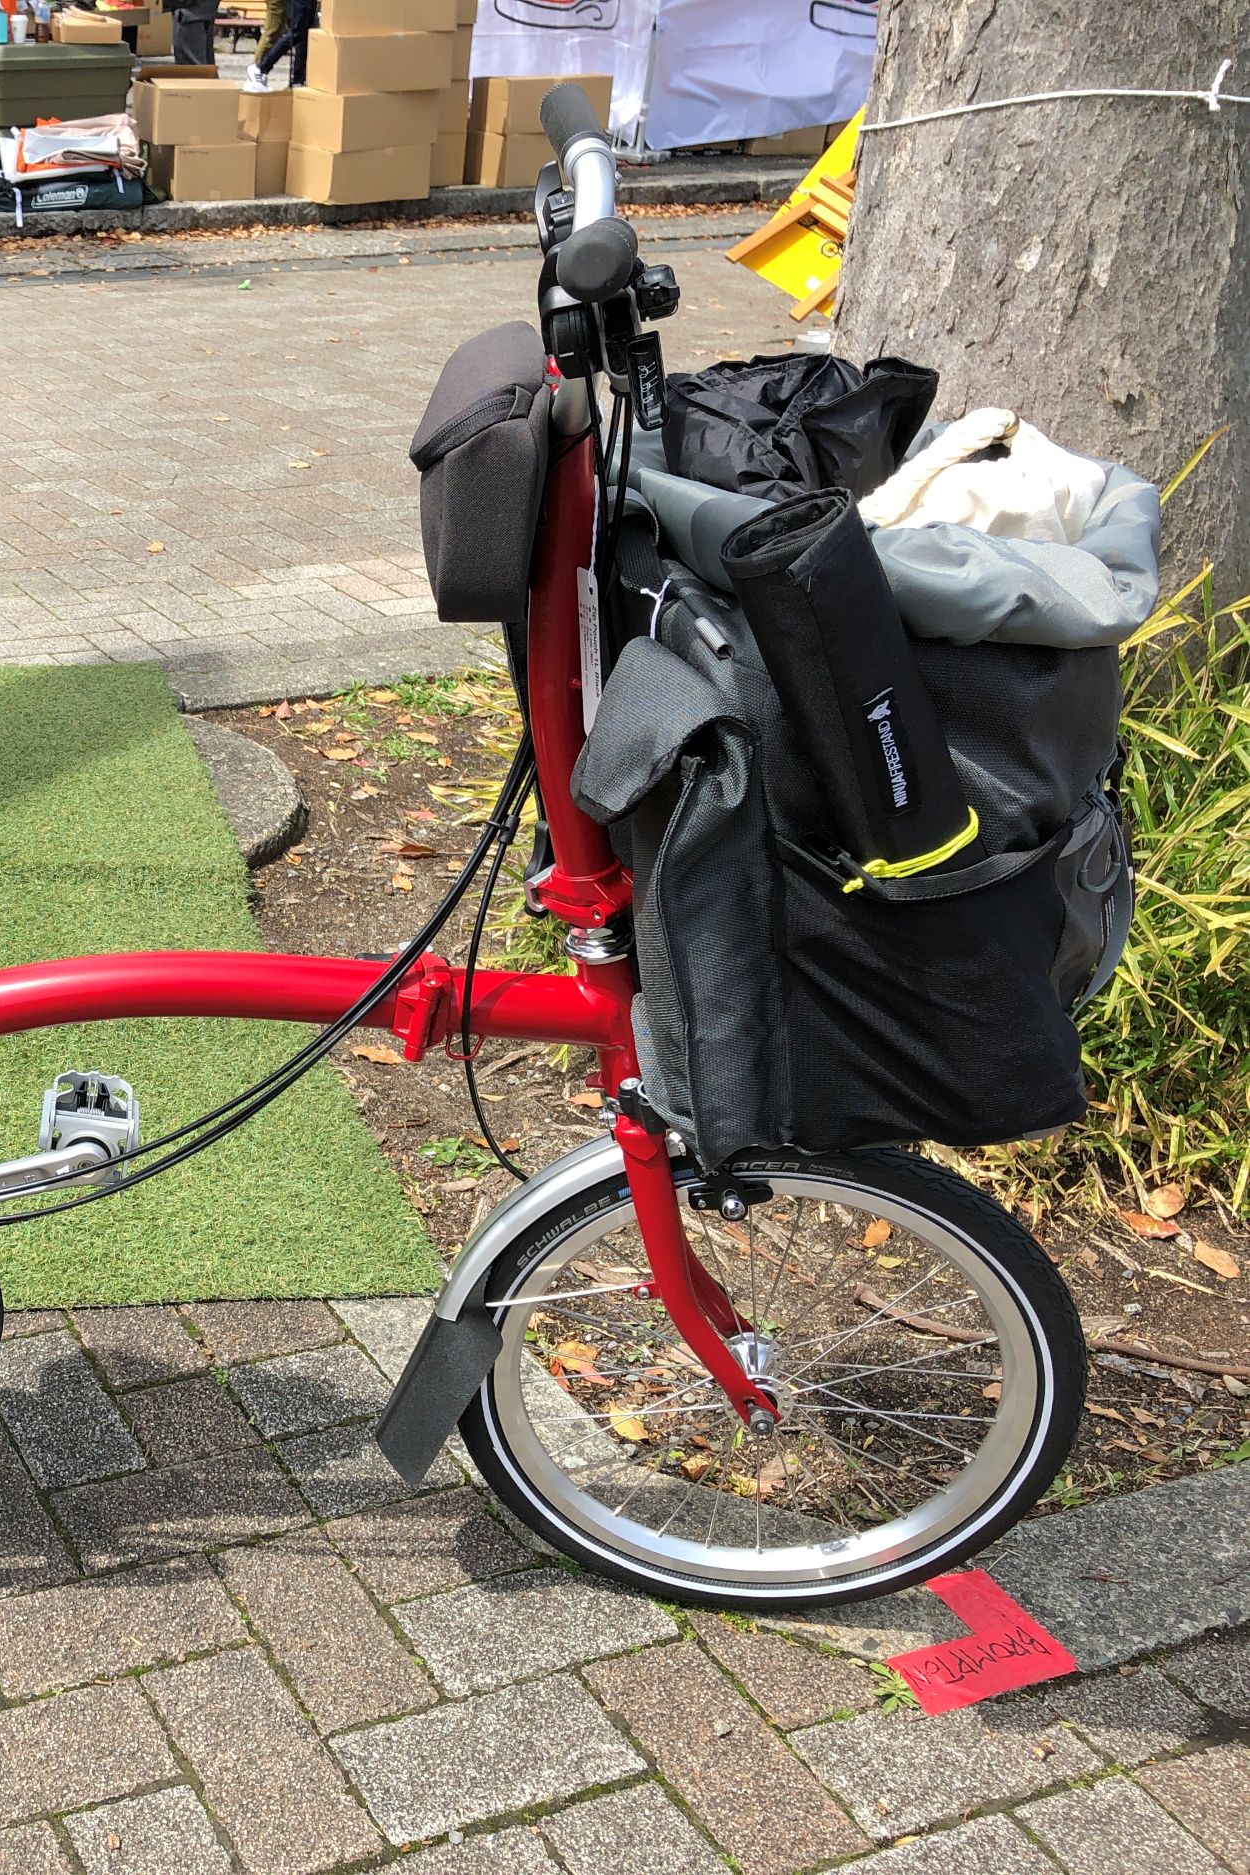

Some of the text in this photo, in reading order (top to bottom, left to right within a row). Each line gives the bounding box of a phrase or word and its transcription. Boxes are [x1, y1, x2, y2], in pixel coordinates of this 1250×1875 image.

[878, 720, 908, 808] NINJAFIRESTAND
[722, 1161, 800, 1172] ACER
[516, 1195, 613, 1269] SCHWALBE
[903, 1626, 1052, 1691] BROMPTON
